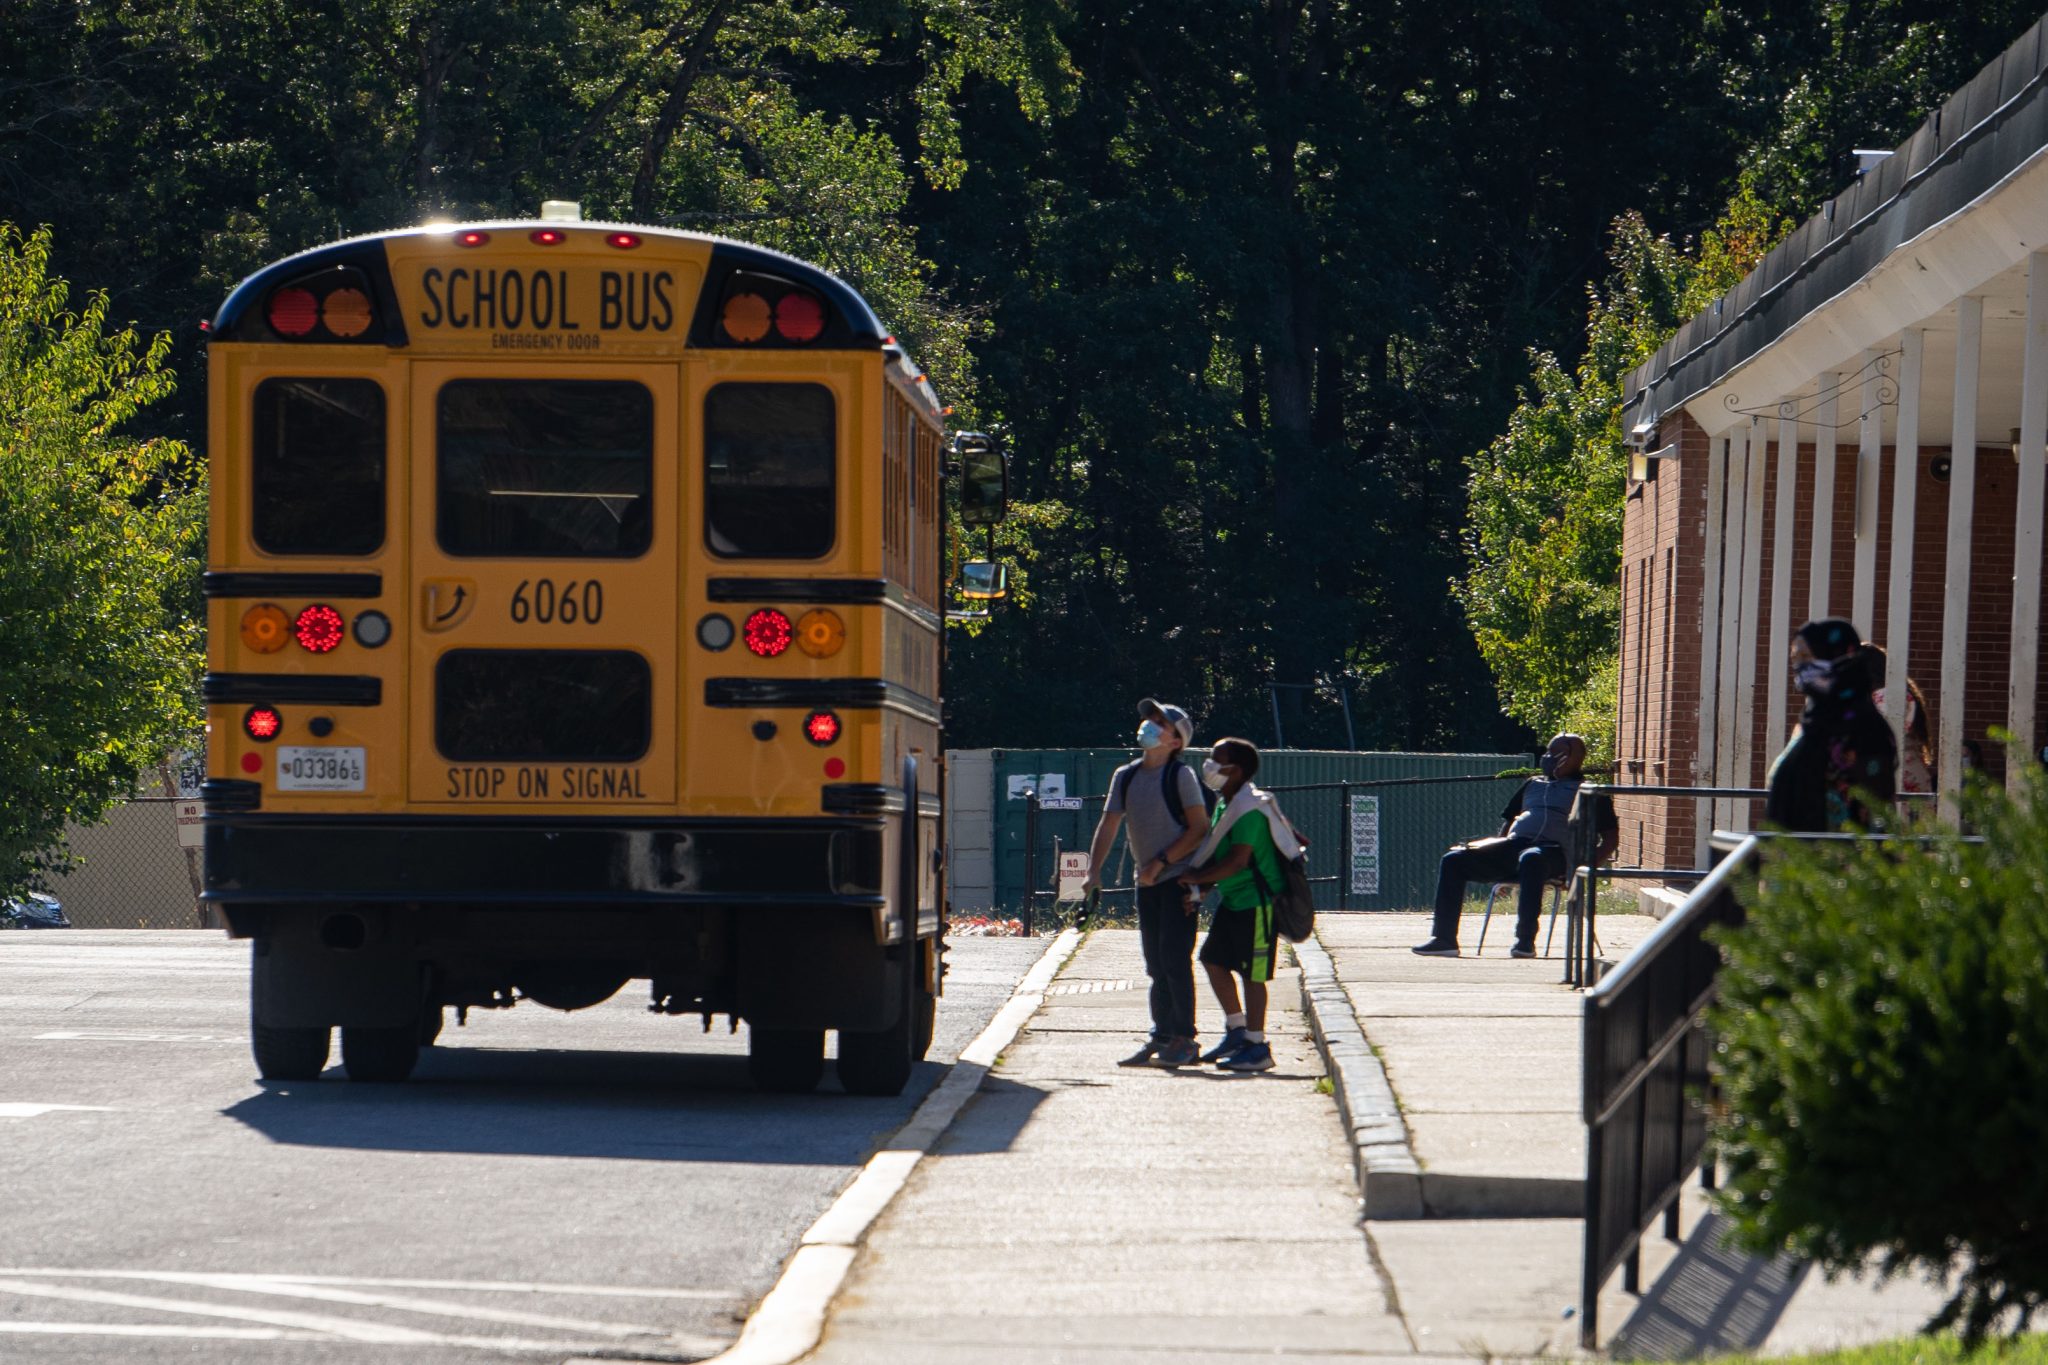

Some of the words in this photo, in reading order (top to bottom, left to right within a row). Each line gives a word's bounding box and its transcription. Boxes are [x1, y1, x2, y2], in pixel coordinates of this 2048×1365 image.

[421, 267, 579, 330] SCHOOL
[601, 271, 674, 331] BUS
[491, 333, 563, 349] EMERGENCY
[567, 333, 600, 350] DOOR
[511, 578, 603, 625] 6060
[293, 757, 349, 780] 03386
[447, 767, 505, 798] STOP
[517, 767, 549, 798] ON
[562, 767, 646, 798] SIGNAL
[184, 806, 197, 815] NO
[1067, 859, 1078, 868] NO
